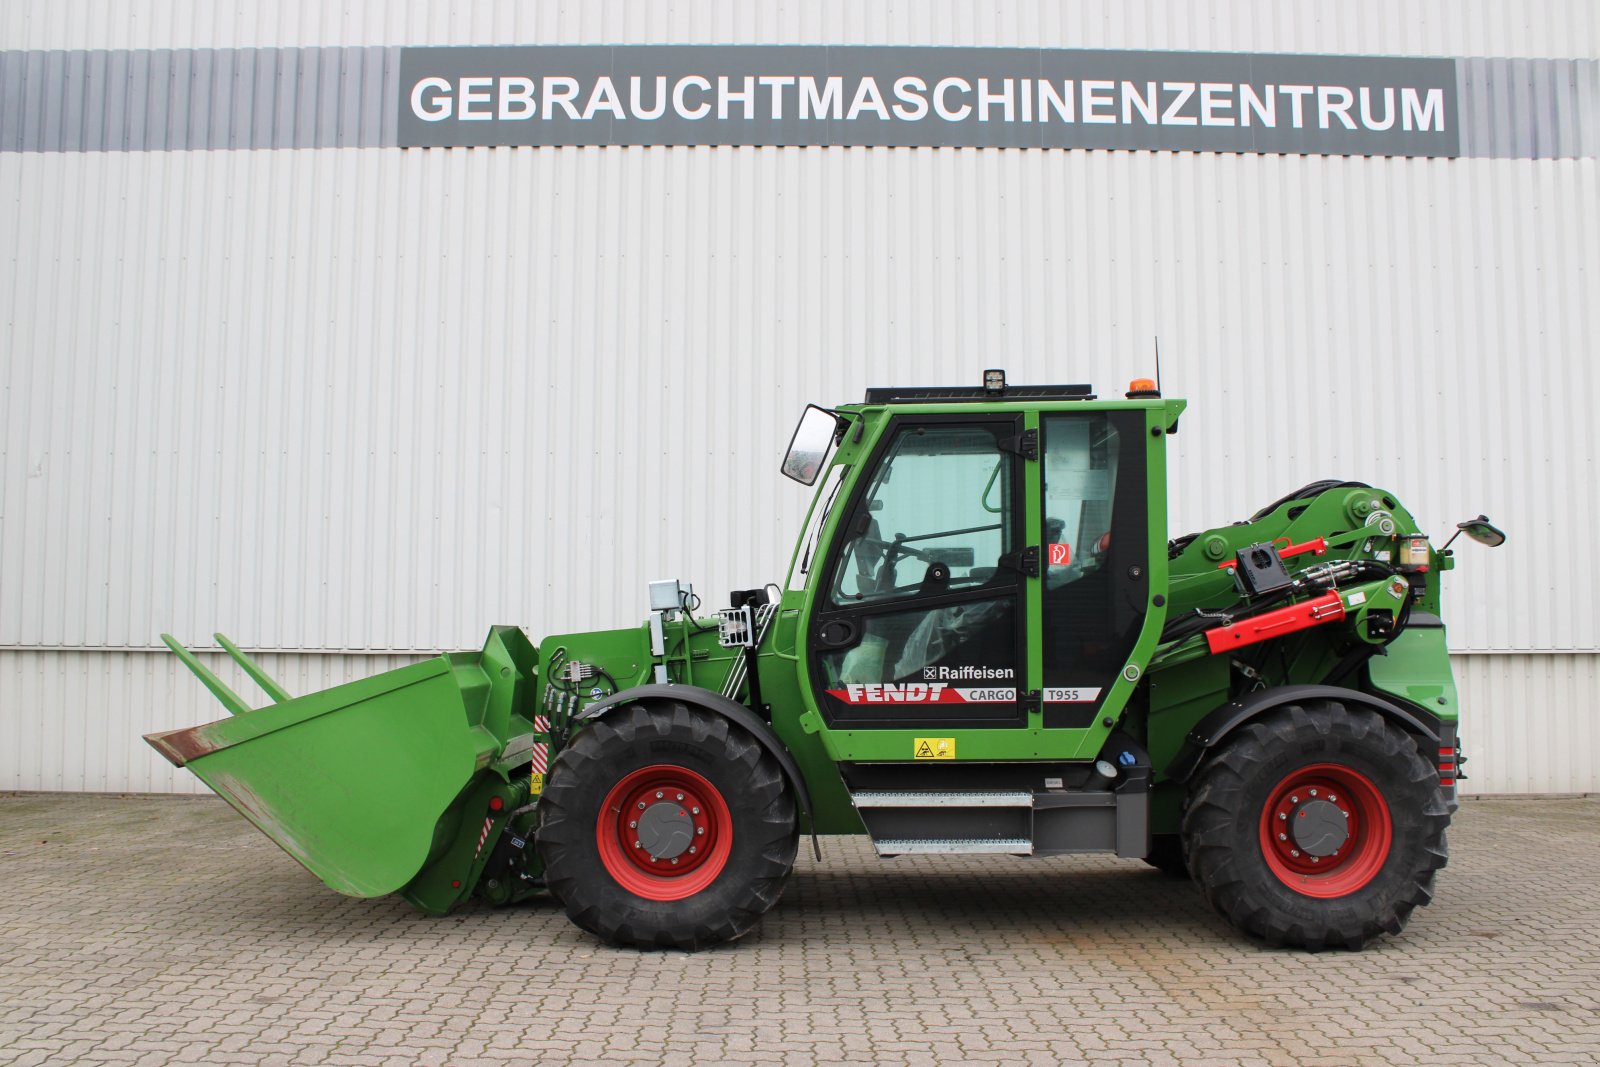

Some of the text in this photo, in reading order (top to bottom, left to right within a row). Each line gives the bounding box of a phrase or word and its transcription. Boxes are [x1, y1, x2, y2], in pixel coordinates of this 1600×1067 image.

[409, 75, 1446, 132] GEBRAUCHTMASCHINENZENTRUM
[939, 666, 1014, 680] Raiffeisen
[846, 683, 1079, 702] FENDT CARGO T955
